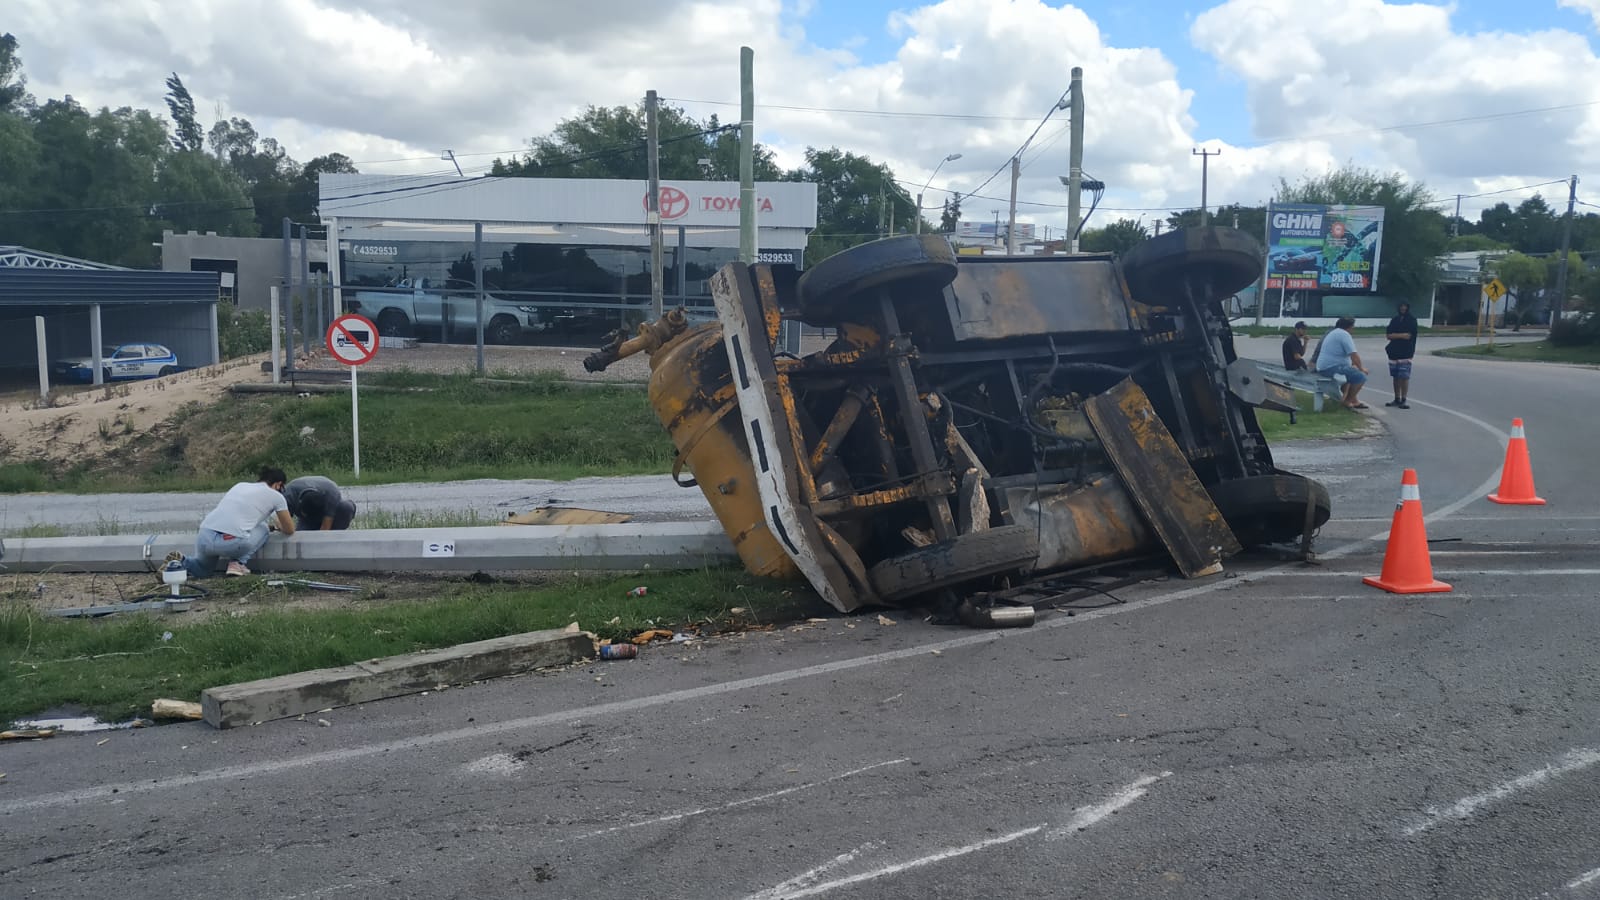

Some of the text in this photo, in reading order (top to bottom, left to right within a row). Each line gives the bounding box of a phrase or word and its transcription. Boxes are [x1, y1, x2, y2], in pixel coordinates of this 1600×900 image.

[702, 196, 773, 211] TOYA
[1273, 213, 1323, 229] GHM
[359, 245, 398, 256] 43529533
